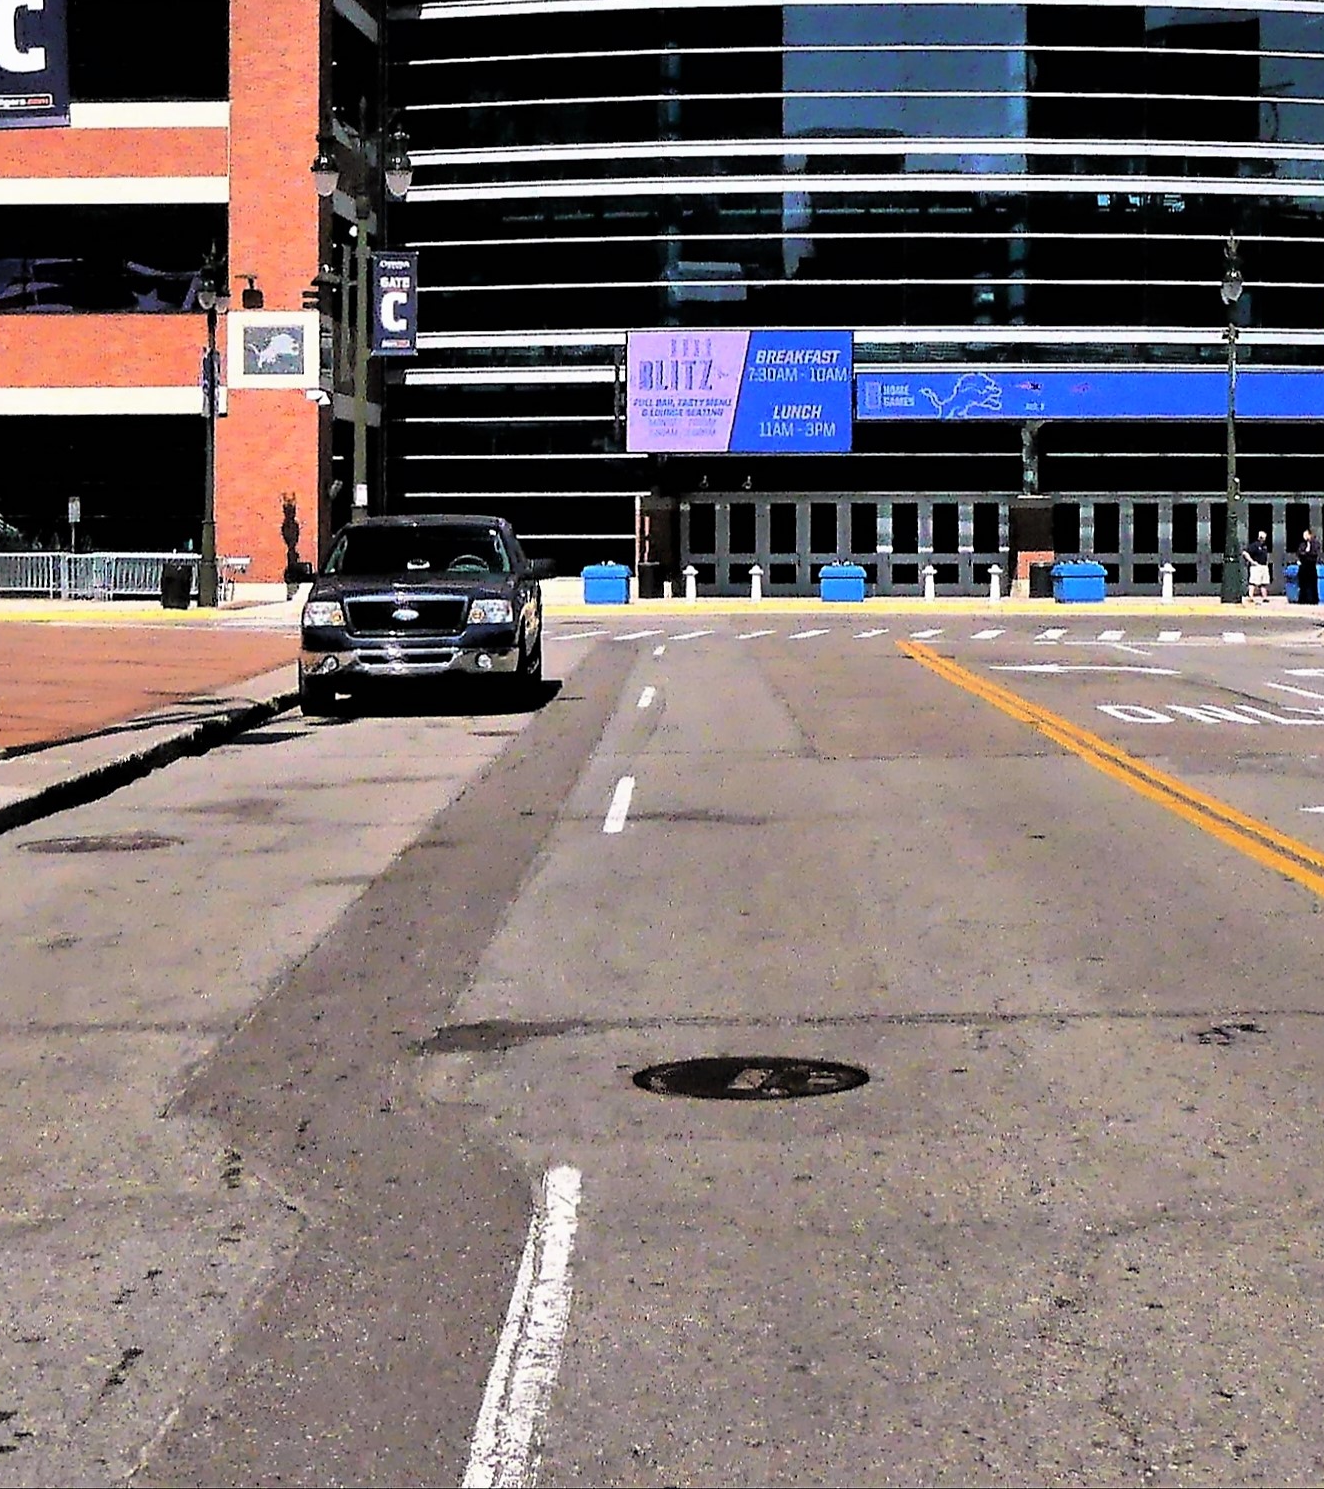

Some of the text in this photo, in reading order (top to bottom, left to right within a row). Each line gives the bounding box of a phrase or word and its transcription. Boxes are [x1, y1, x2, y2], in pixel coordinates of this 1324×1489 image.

[380, 276, 411, 288] GATE
[381, 291, 408, 332] C
[755, 349, 842, 364] BREAKFAST
[638, 360, 714, 391] BLITZ
[748, 367, 798, 383] 7:30AM
[810, 367, 848, 382] 10AM
[773, 404, 823, 419] LUNCH
[759, 422, 795, 437] 11AM
[805, 423, 836, 437] 3PM
